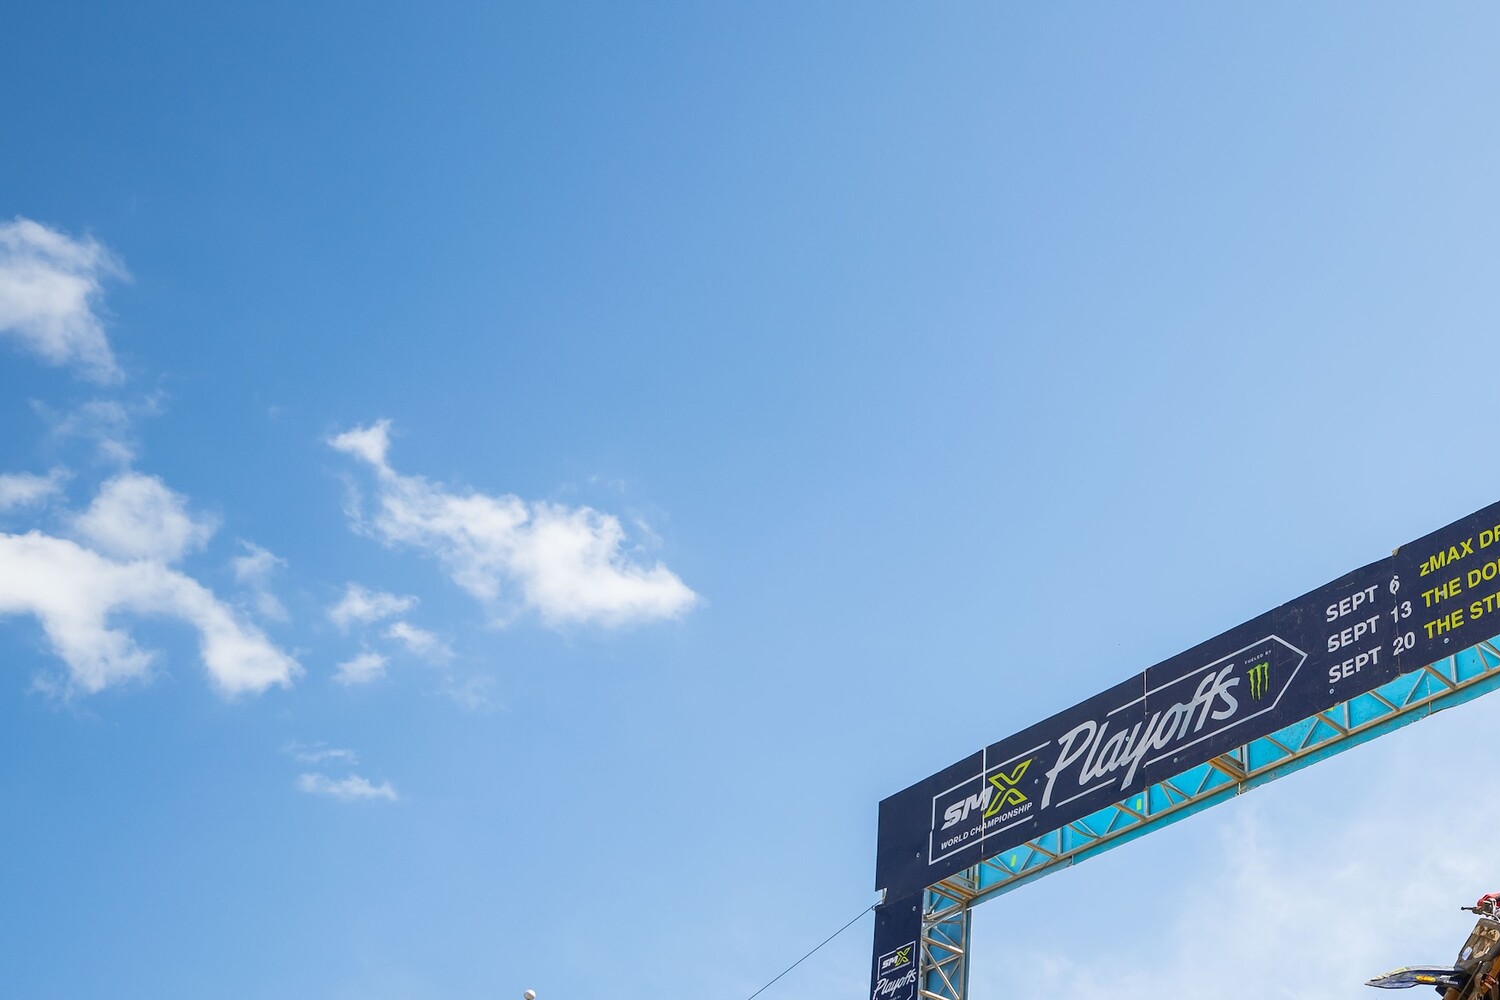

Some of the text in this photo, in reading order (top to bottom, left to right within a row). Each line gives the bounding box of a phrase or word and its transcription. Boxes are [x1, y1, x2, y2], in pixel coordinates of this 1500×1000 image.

[1326, 585, 1378, 623] SEPT
[1389, 575, 1400, 595] 6
[1419, 537, 1474, 577] zMAX
[1327, 615, 1380, 653] SEPT
[1390, 600, 1413, 624] 13
[1421, 577, 1462, 608] THE
[1244, 653, 1264, 665] FUELED
[1328, 646, 1382, 684] SEPT
[1392, 631, 1416, 656] 20
[1424, 609, 1465, 640] THE
[1041, 663, 1241, 810] Playoffs
[941, 758, 1033, 831] SMX
[941, 802, 1033, 850] WORLD CHAMPIONSHIP
[872, 967, 917, 1000] Playoffs
[882, 946, 912, 970] SMX
